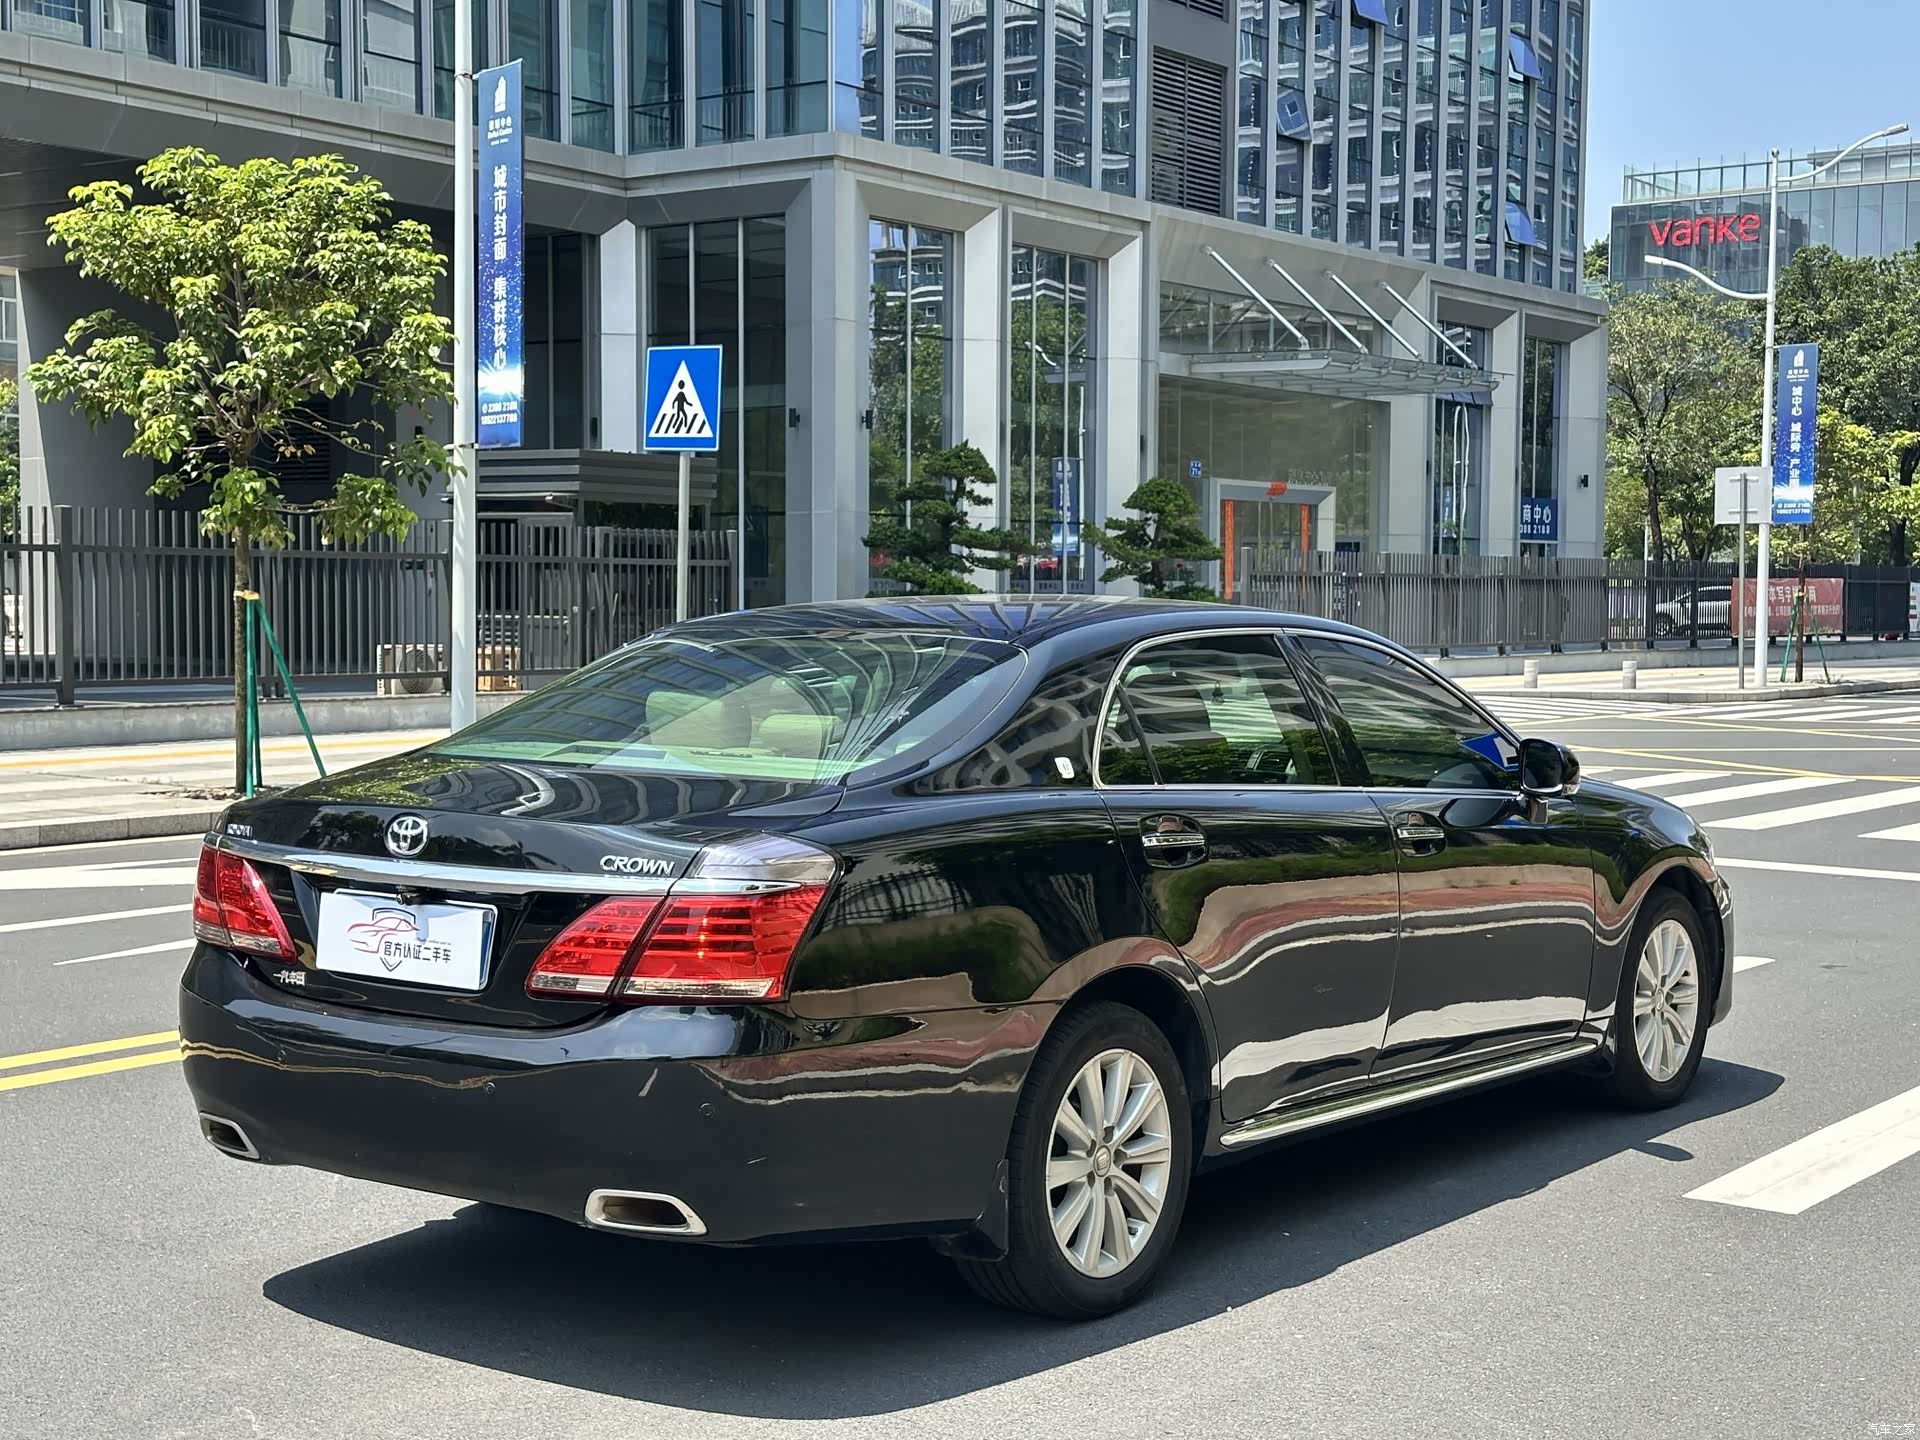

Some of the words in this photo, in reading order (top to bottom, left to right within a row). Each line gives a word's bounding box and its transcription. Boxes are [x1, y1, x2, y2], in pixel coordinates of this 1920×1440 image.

[493, 164, 508, 261] 城市封面
[1648, 212, 1761, 248] vanke
[493, 275, 508, 371] 集群核心
[1522, 504, 1552, 524] 商中心
[600, 855, 675, 876] CROWN
[384, 941, 452, 964] 官方认证二手车
